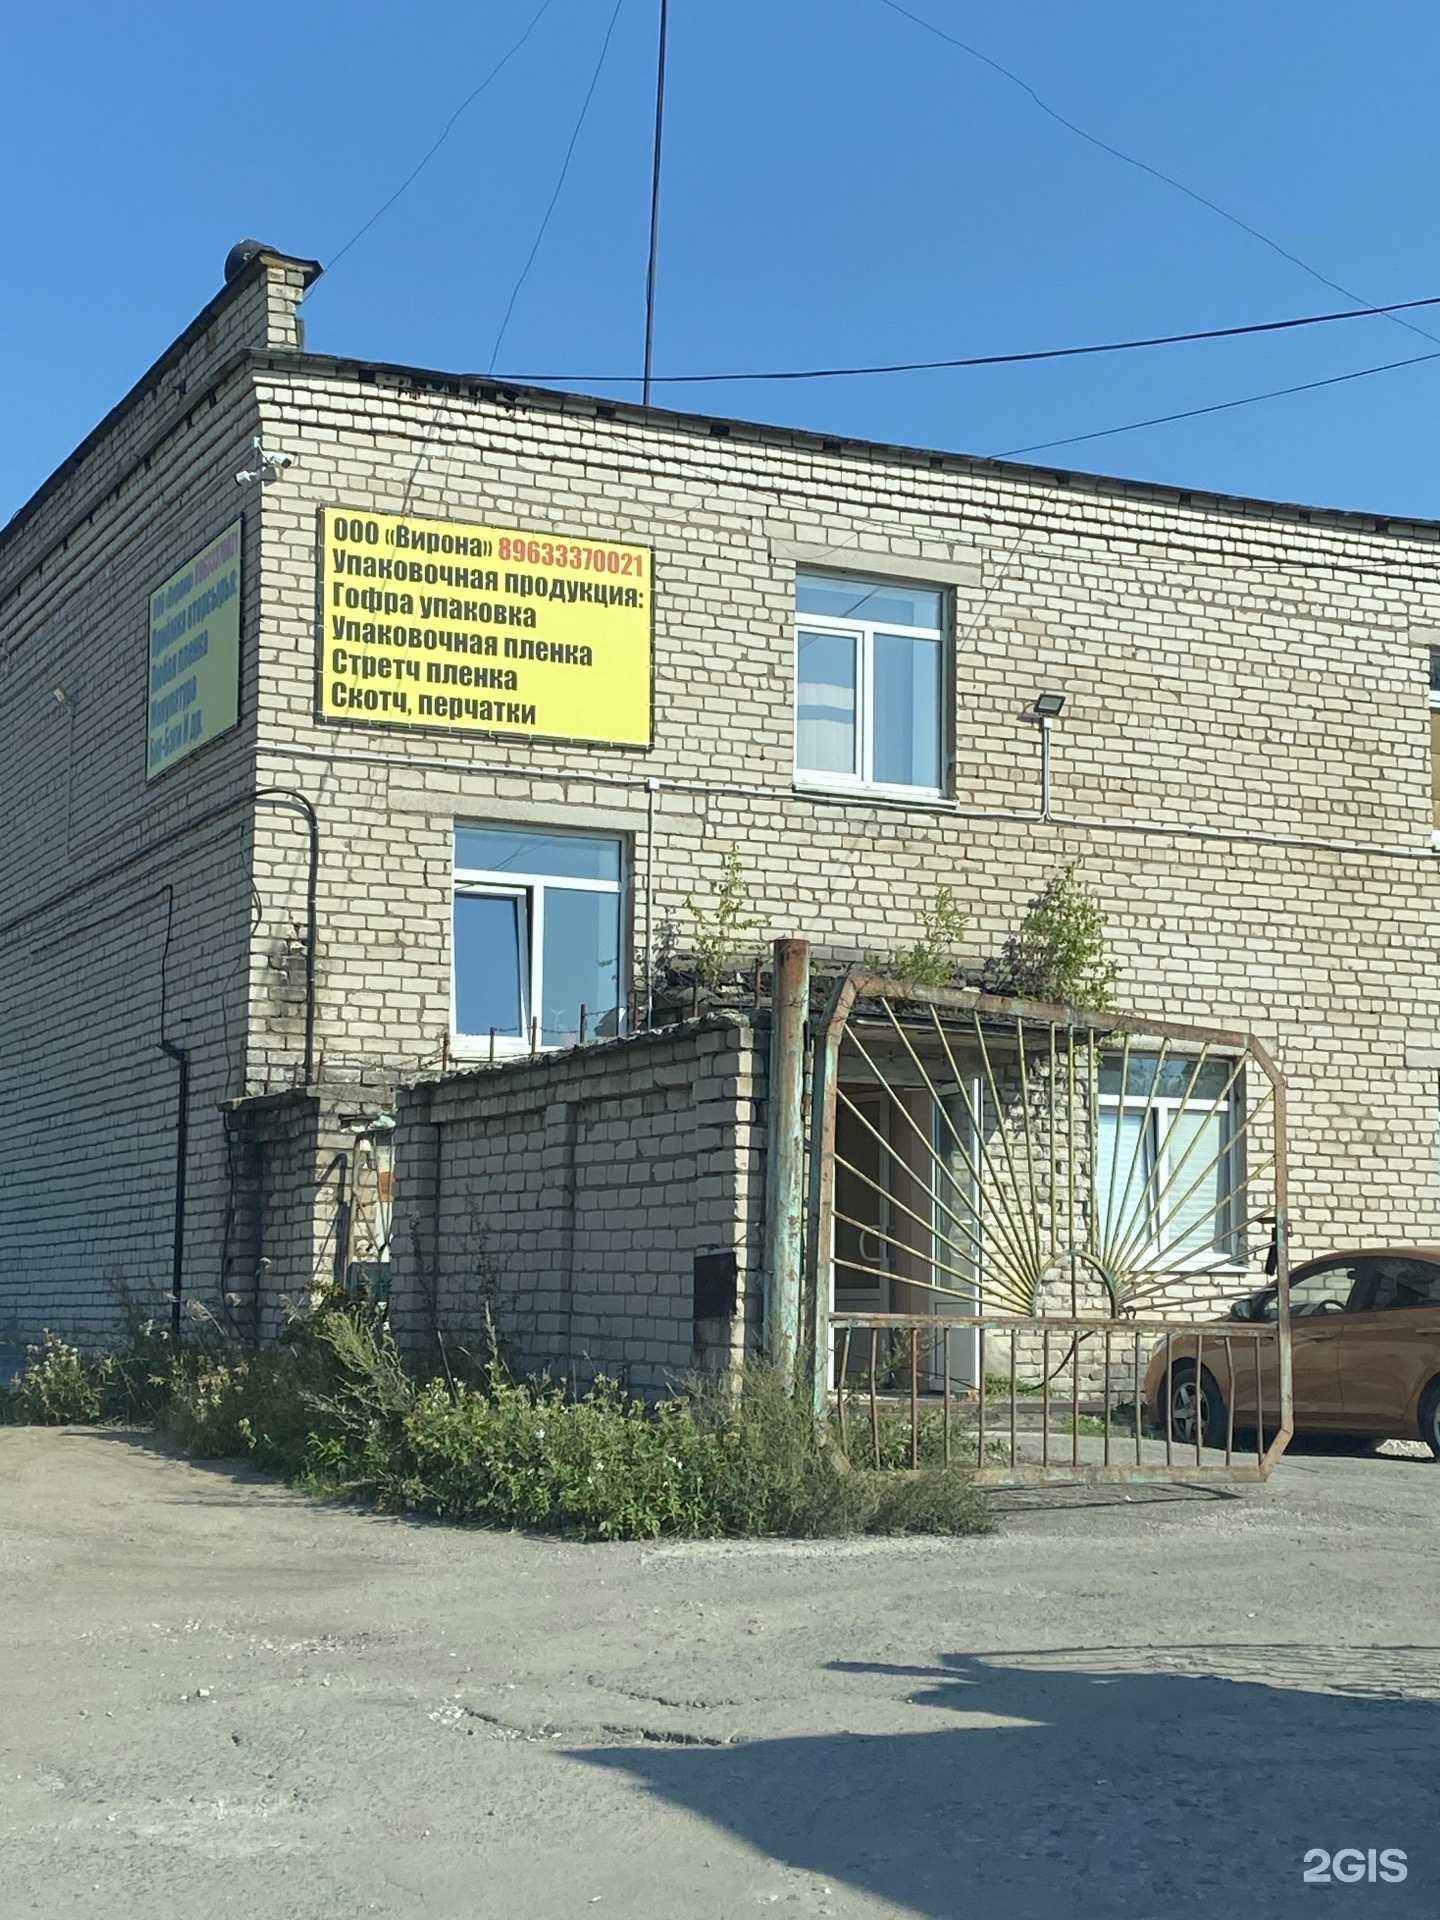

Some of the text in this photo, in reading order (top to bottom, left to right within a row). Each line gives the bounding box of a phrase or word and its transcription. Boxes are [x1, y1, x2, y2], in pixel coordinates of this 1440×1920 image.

[333, 548, 644, 609] Упаковочная продукция:
[498, 537, 643, 577] 89633370021
[334, 582, 536, 628] Гофра упаковка
[332, 615, 593, 666] Упаковочная пленка
[332, 648, 517, 691] Стретч пленка
[332, 681, 536, 725] Скотч, перчатки
